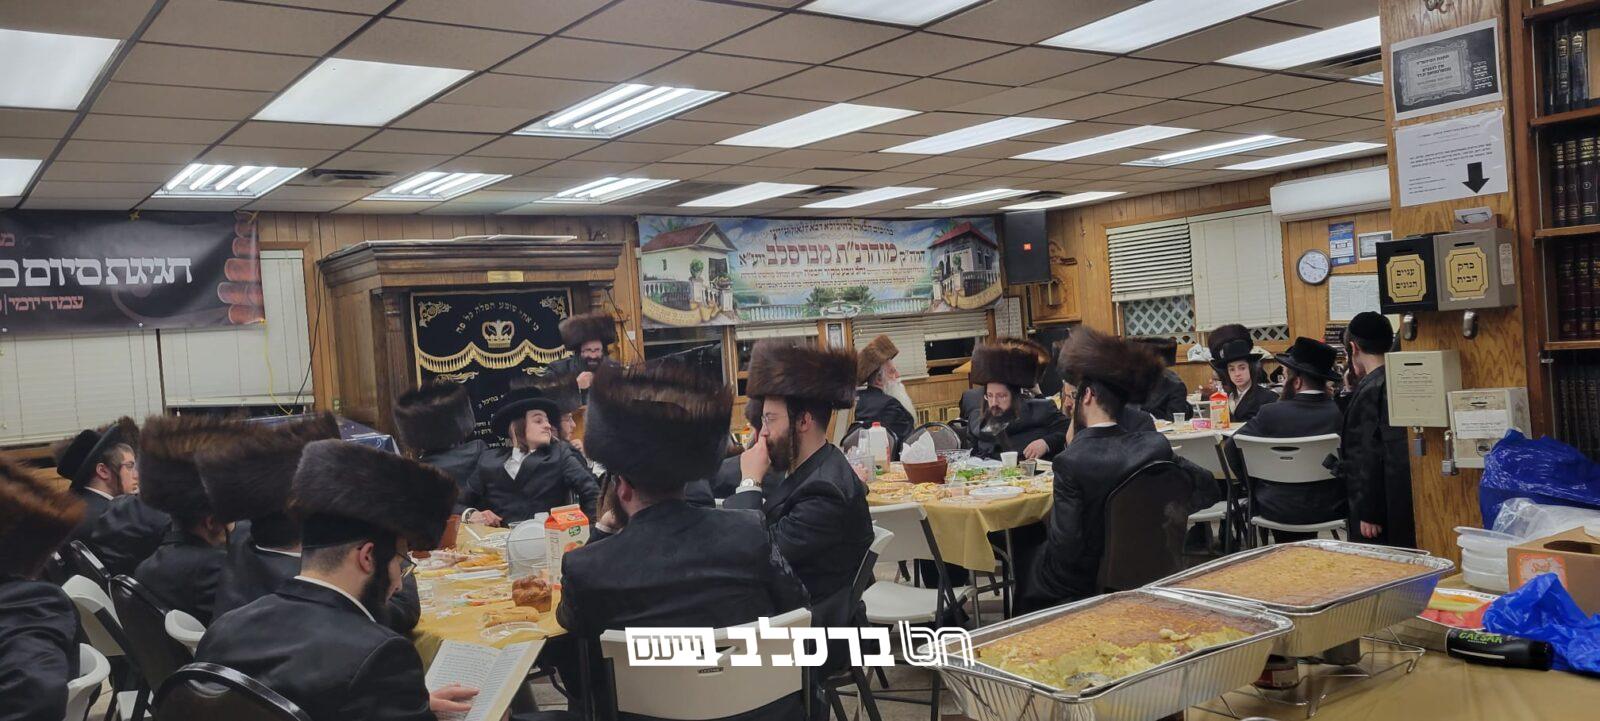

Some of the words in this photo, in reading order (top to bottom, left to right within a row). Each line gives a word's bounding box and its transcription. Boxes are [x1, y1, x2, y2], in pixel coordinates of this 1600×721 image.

[766, 233, 832, 265] מברסלב
[22, 257, 102, 286] סיום
[105, 256, 193, 285] חגיגת
[1396, 268, 1415, 276] עניים
[1457, 262, 1475, 272] בדק
[1456, 275, 1478, 284] הבית
[8, 296, 41, 311] יומי
[41, 295, 84, 310] עמוד
